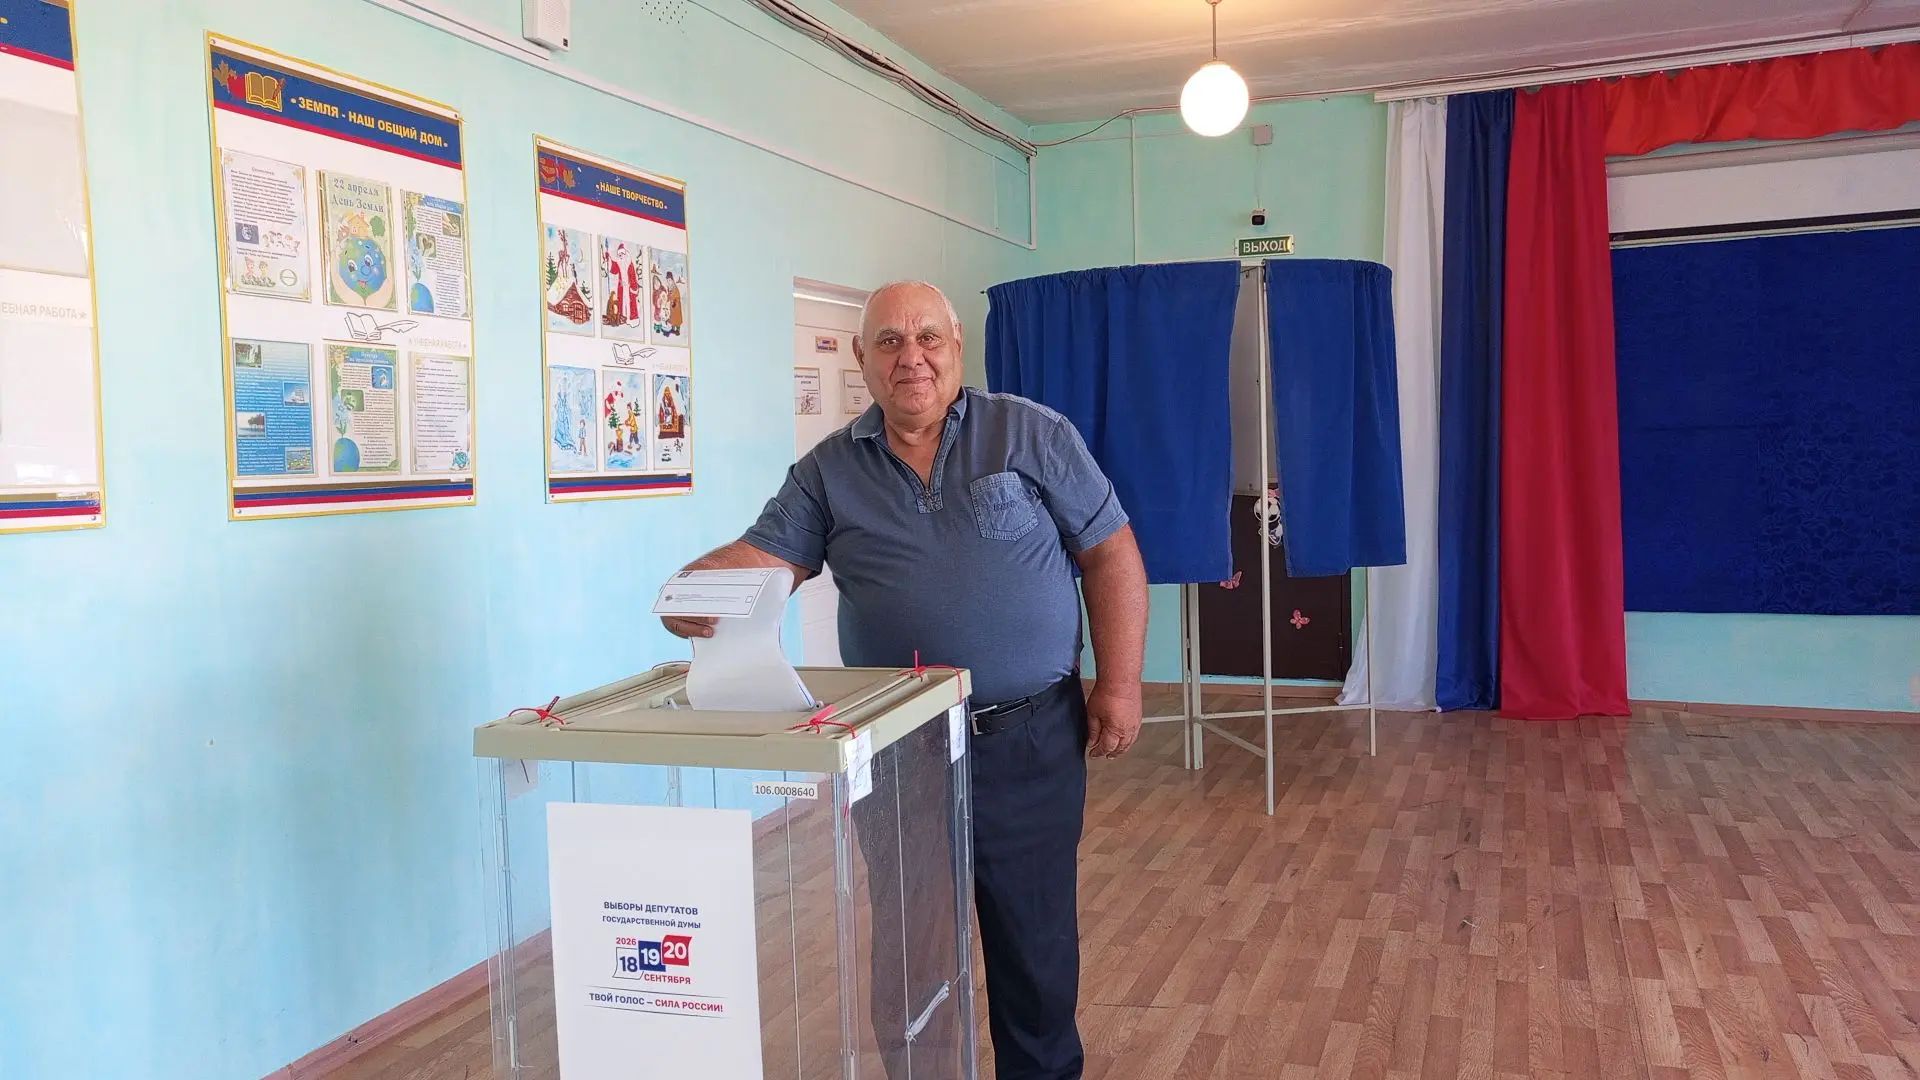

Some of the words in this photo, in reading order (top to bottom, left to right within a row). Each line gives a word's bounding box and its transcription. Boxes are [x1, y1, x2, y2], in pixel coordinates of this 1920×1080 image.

[299, 97, 339, 119] ЗЕМЛЯ
[348, 111, 375, 128] НАШ
[377, 119, 417, 140] ОБЩИЙ
[420, 131, 443, 147] ДОМ
[333, 178, 344, 189] 22
[347, 182, 379, 197] апреля
[600, 181, 621, 197] НАШЕ
[622, 189, 664, 210] ТВОРЧЕСТВО
[356, 198, 384, 213] Земли
[1243, 239, 1287, 253] ВЫХОД
[1, 302, 37, 316] ЕБНАЯ
[754, 784, 816, 797] 106.0008640
[603, 901, 643, 912] ВЫБОРЫ
[645, 904, 698, 916] ДЕПУТАТОВ
[602, 915, 676, 928] ГОСУДАРСТВЕННОЙ
[677, 920, 701, 929] ДУМЫ
[615, 937, 637, 946] 2026
[619, 956, 638, 972] 18
[641, 948, 660, 966] 19
[663, 941, 687, 960] 20
[644, 973, 691, 985] СЕНТЯБРЯ
[589, 992, 613, 1003] ТВОЙ
[615, 995, 645, 1006] ГОЛОС
[655, 999, 680, 1009] СИЛА
[682, 1002, 724, 1013] РОССИИ!
